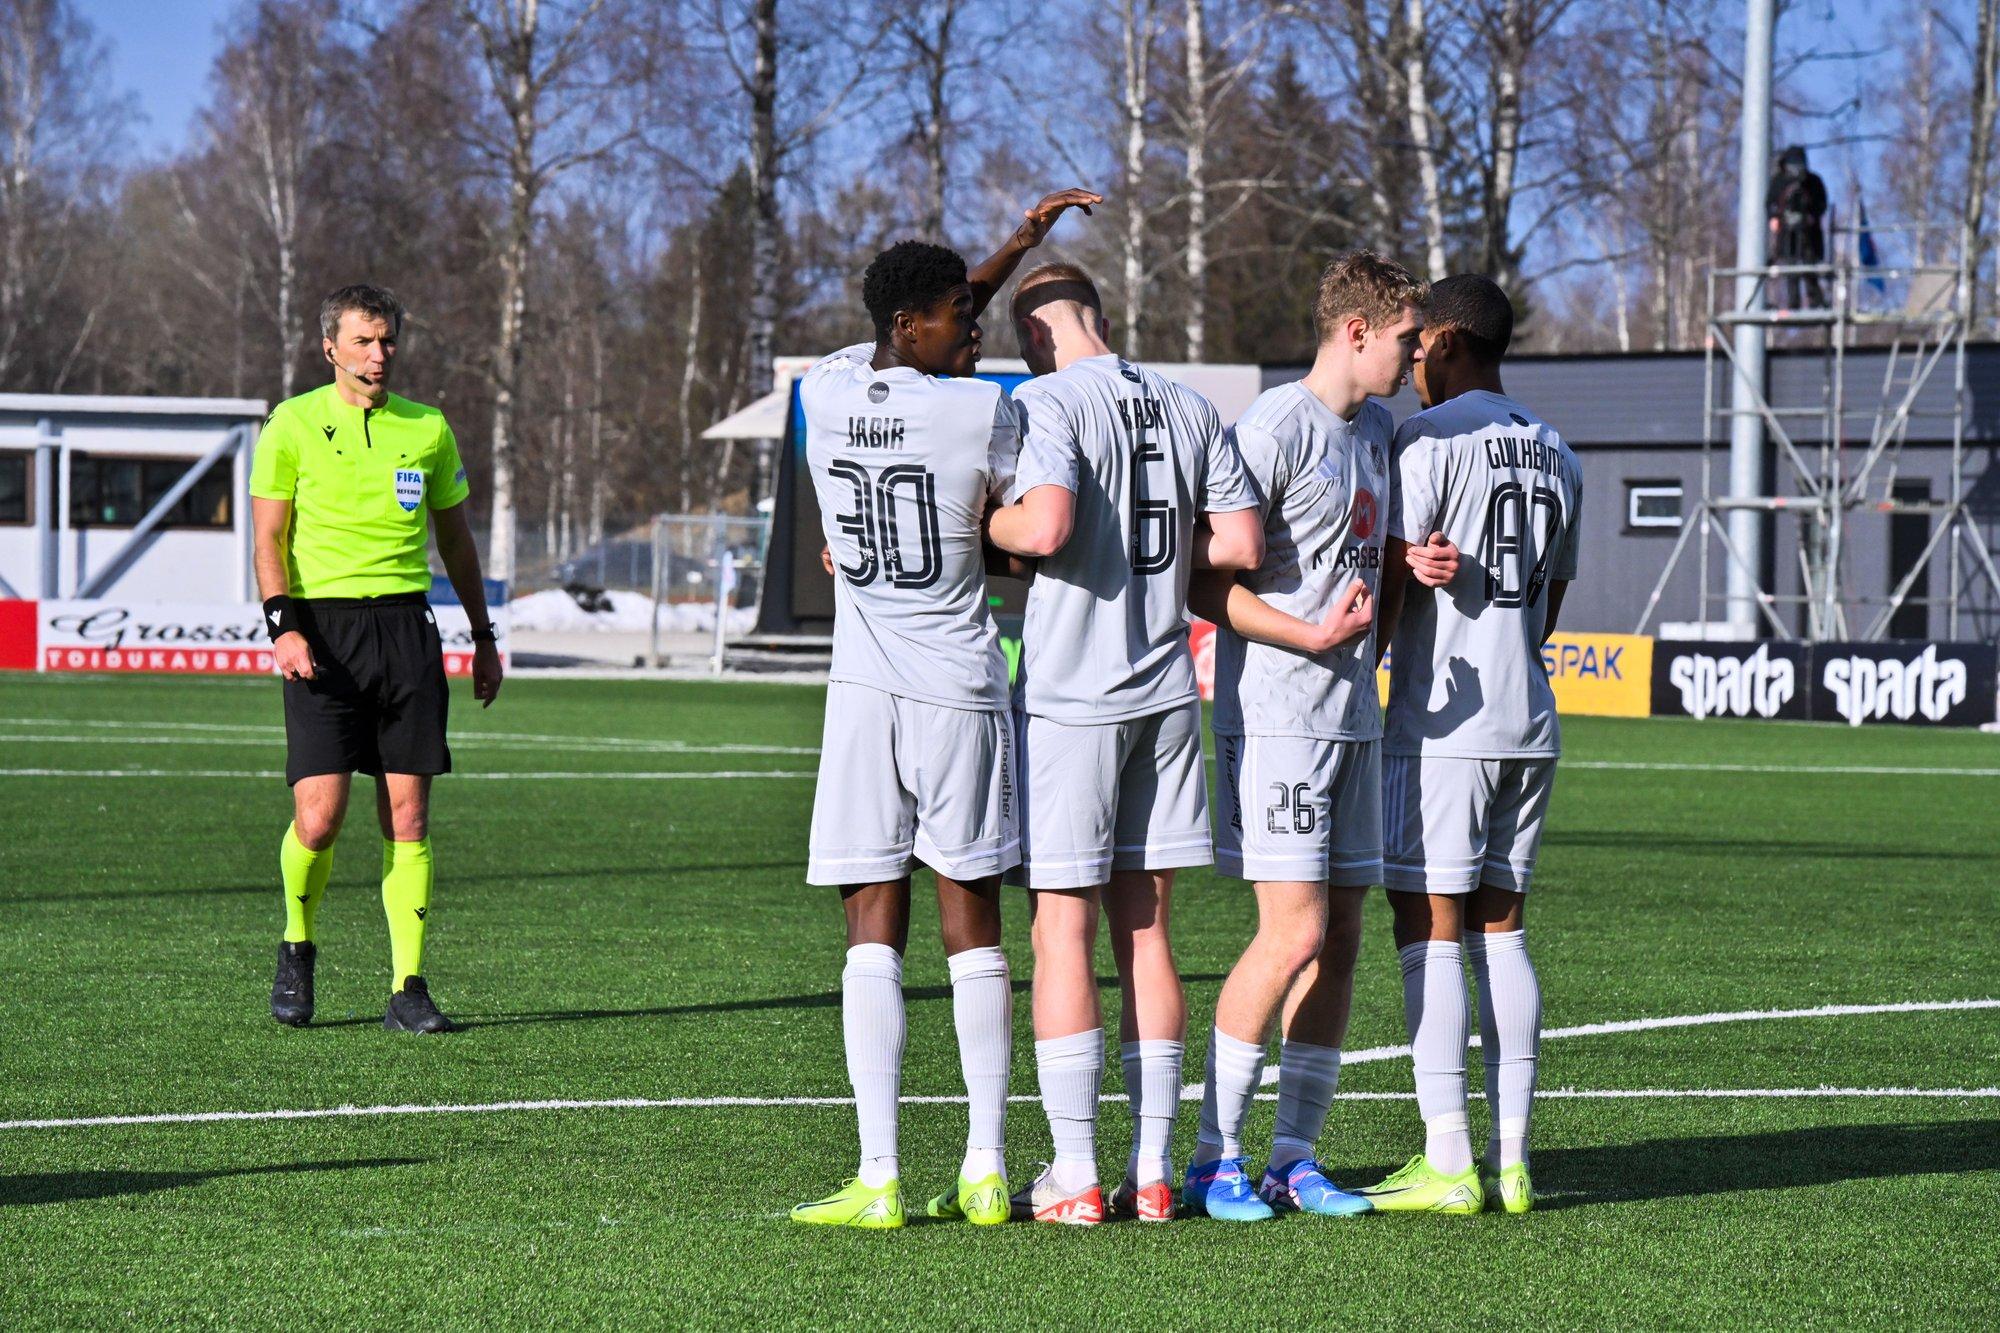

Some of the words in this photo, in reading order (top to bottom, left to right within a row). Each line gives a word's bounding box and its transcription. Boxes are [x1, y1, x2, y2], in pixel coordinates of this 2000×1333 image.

[845, 416, 906, 450] JABIR
[1118, 398, 1165, 431] KASK
[397, 472, 421, 483] FIFA
[397, 488, 421, 496] REFEREE
[828, 459, 943, 590] 30
[1129, 442, 1177, 576] 6
[50, 606, 266, 651] Grossi
[47, 650, 273, 671] TOIDUKAUBAD
[1670, 642, 1795, 720] sparta
[1823, 643, 1967, 727] sparta
[1267, 781, 1316, 835] 26
